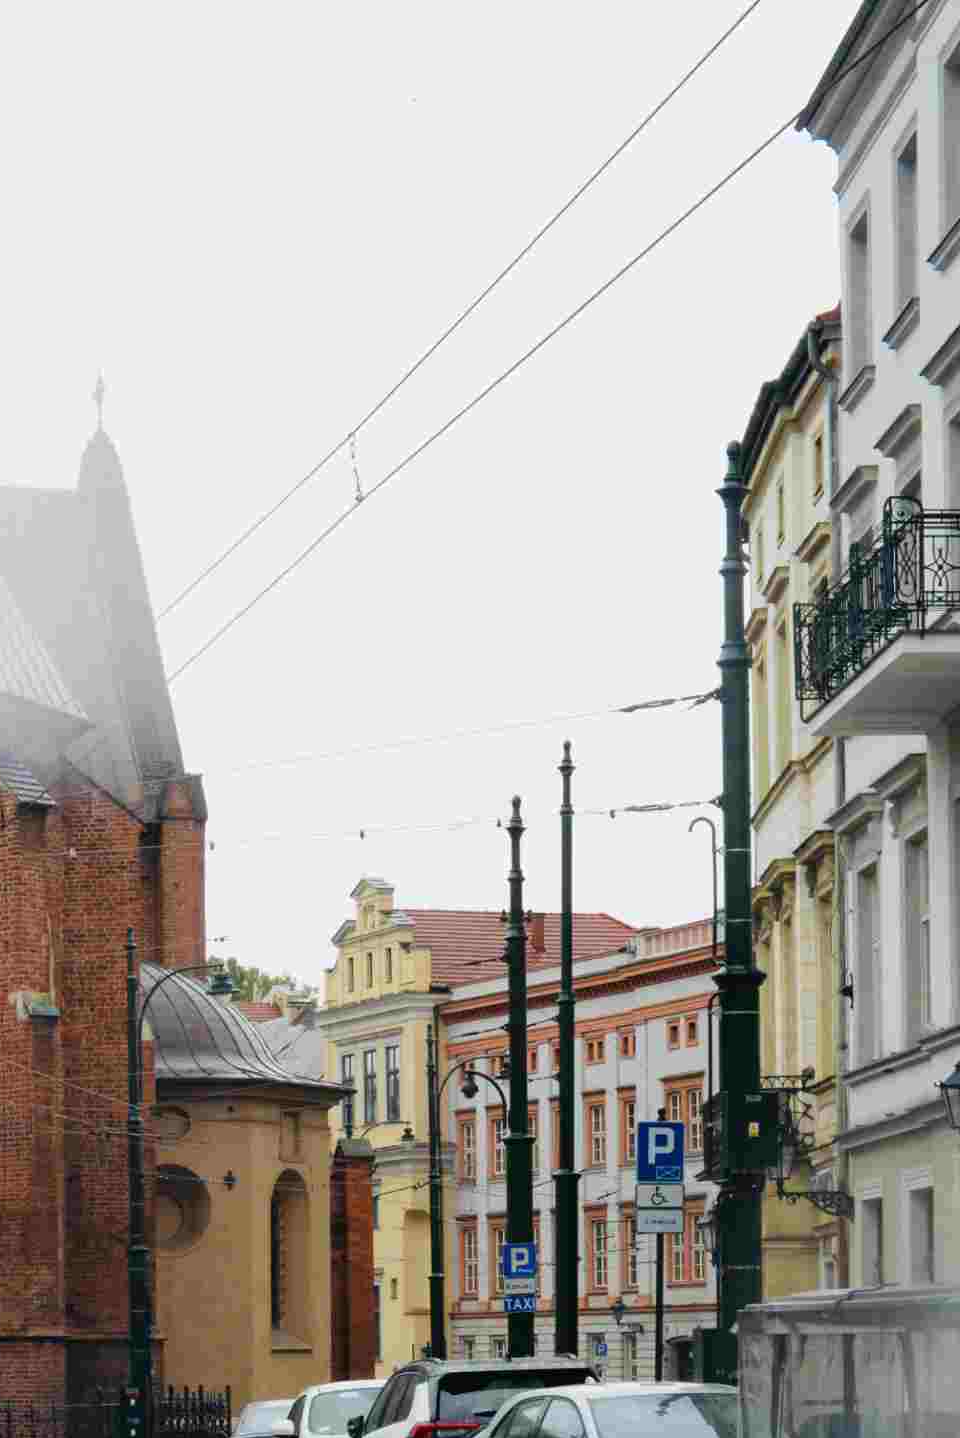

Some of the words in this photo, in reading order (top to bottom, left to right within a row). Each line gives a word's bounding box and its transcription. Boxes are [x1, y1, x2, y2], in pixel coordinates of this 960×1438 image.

[647, 1127, 675, 1165] P
[511, 1247, 529, 1272] P
[505, 1298, 536, 1310] TAXI
